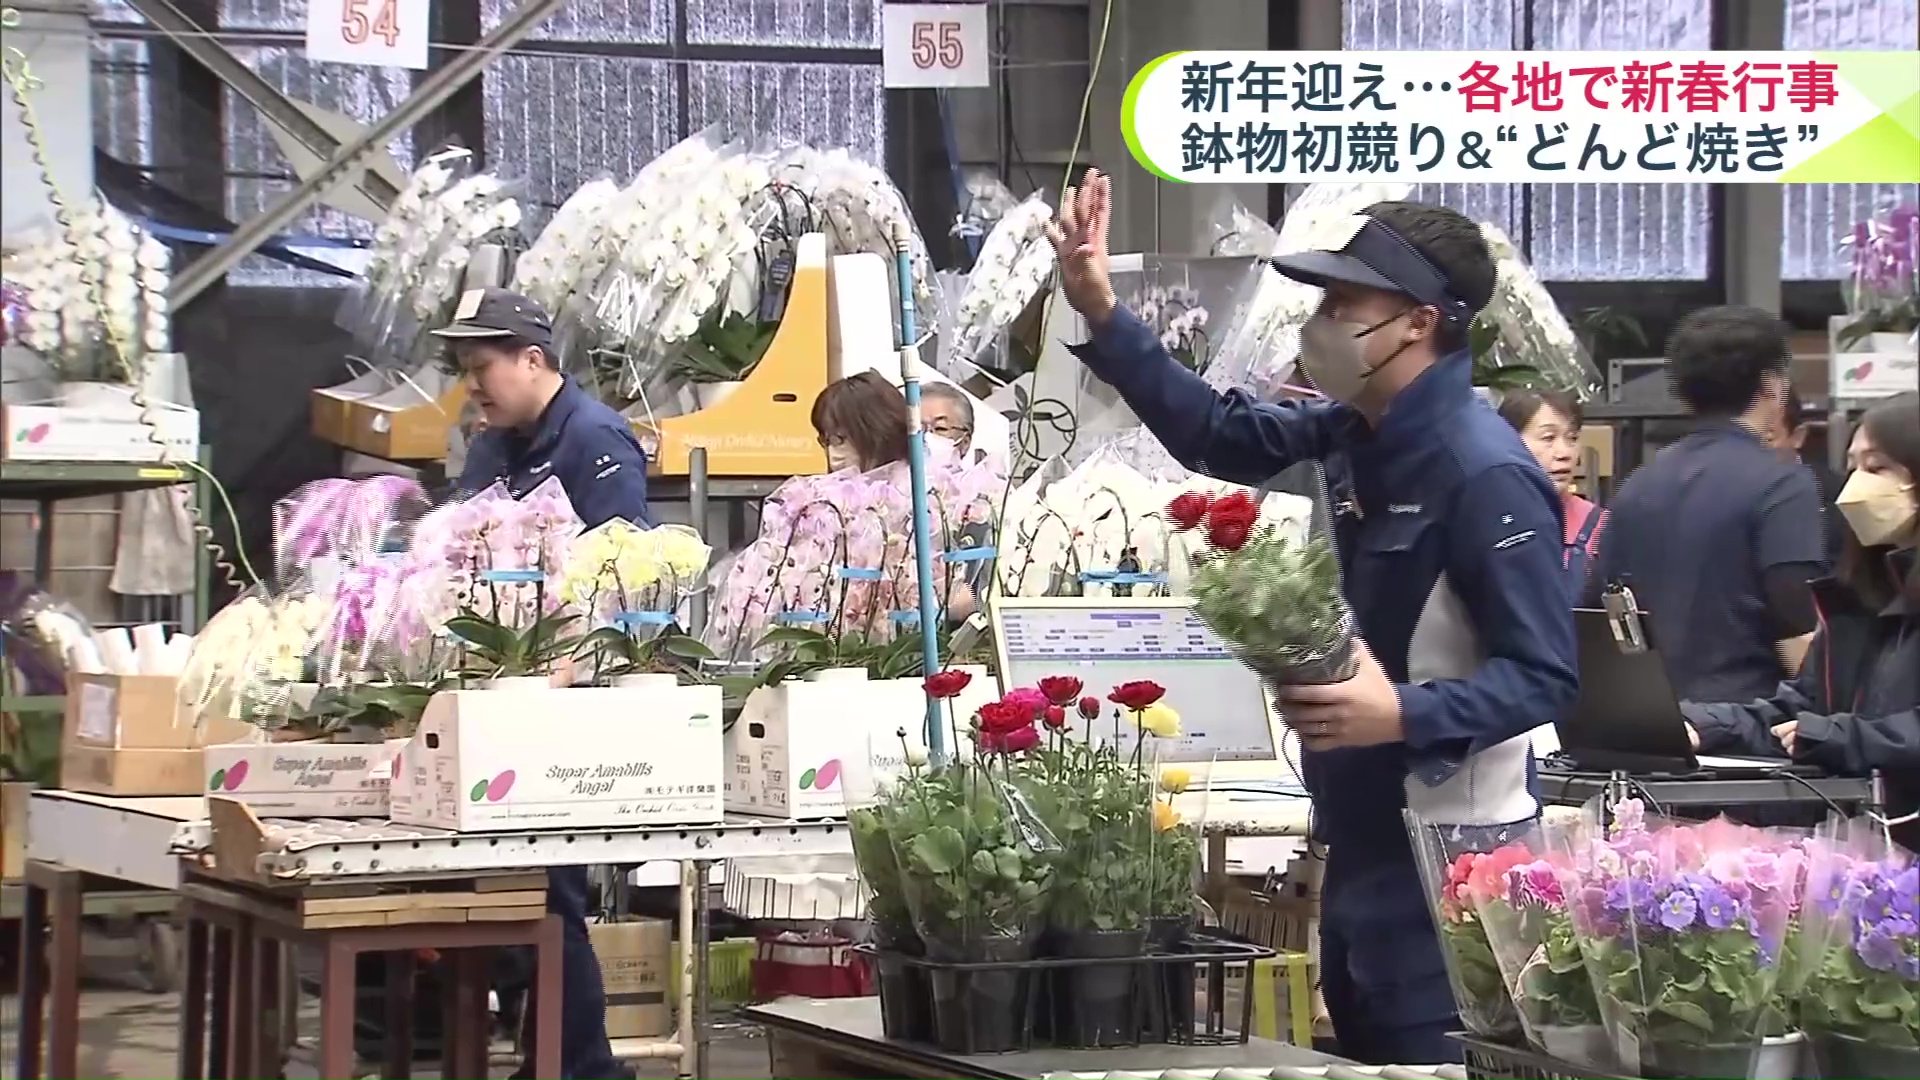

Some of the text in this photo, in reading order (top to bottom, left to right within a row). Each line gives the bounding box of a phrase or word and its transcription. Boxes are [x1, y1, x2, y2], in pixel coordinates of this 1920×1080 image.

[341, 0, 400, 47] 54
[911, 21, 964, 69] 55
[545, 762, 653, 782] Super Amabilis
[570, 779, 616, 798] Angel
